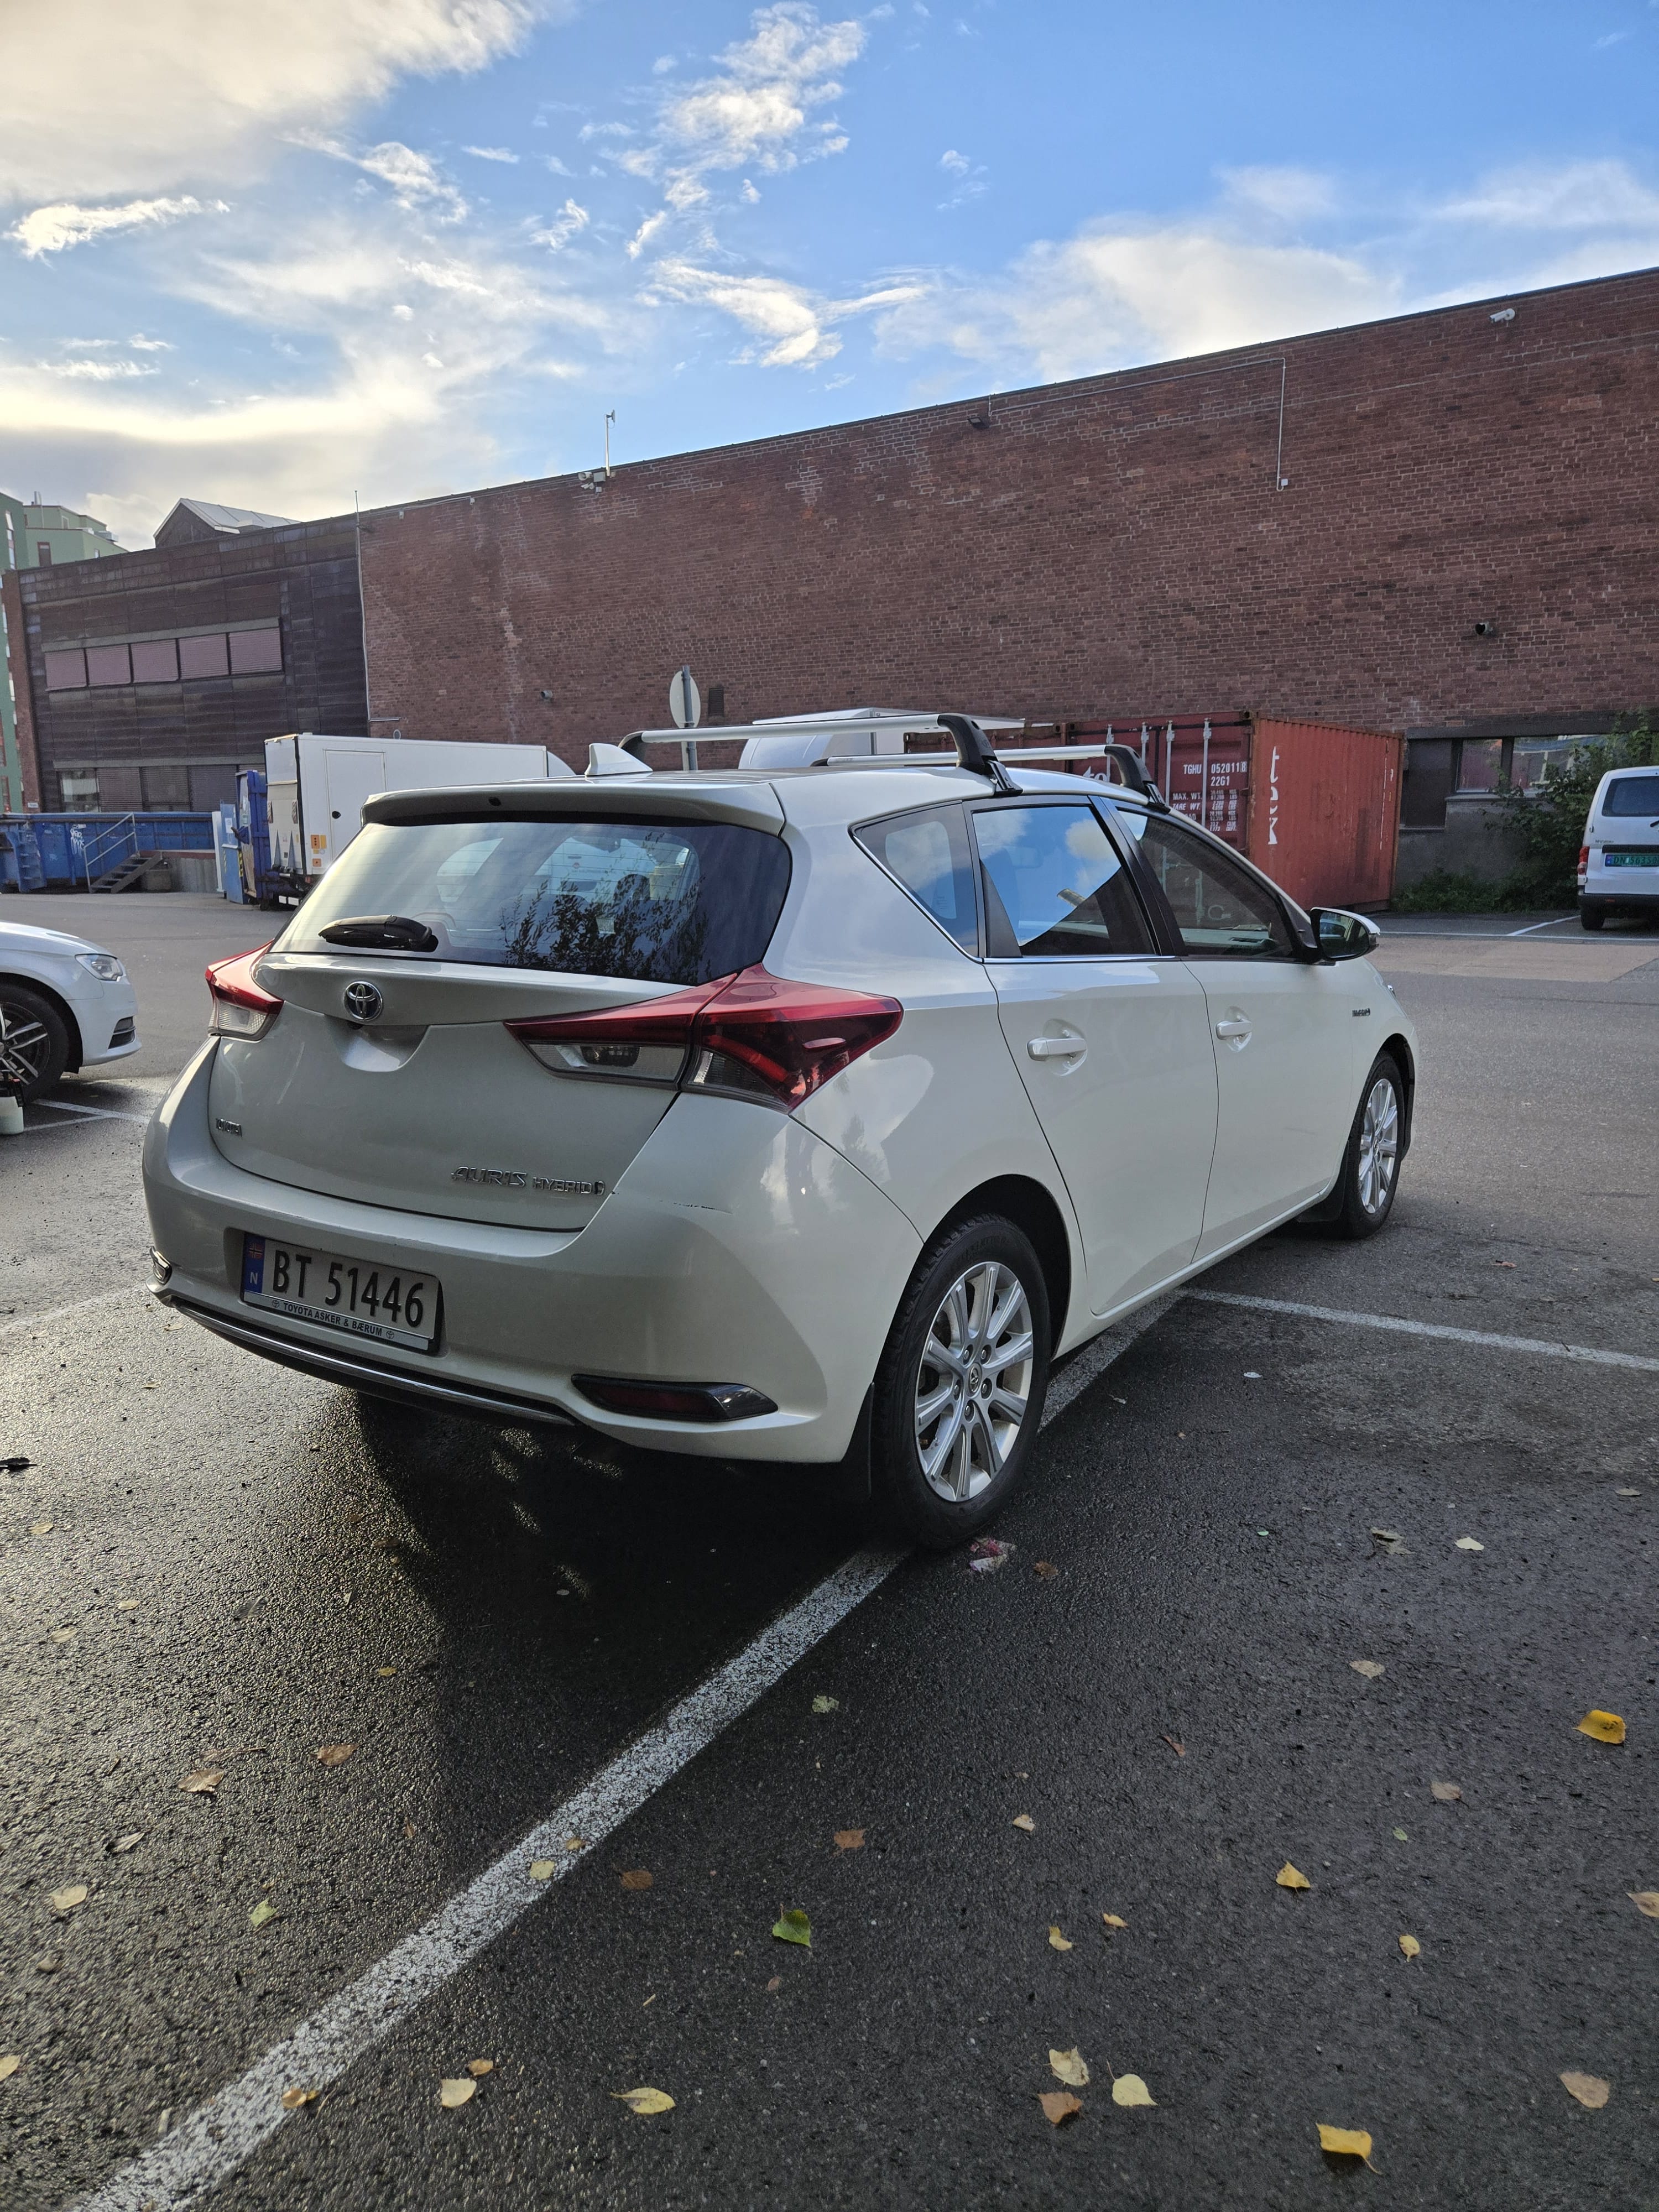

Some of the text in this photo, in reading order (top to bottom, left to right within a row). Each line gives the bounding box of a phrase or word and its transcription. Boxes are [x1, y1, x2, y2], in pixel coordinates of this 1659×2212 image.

[1183, 764, 1202, 774] TGHU
[1211, 776, 1230, 786] 22G1
[451, 1166, 593, 1194] AURIS HYBRID
[250, 1271, 258, 1286] N
[273, 1249, 424, 1328] BT 51446
[283, 1302, 382, 1337] TOYOTA ASKER & BÆRUM
